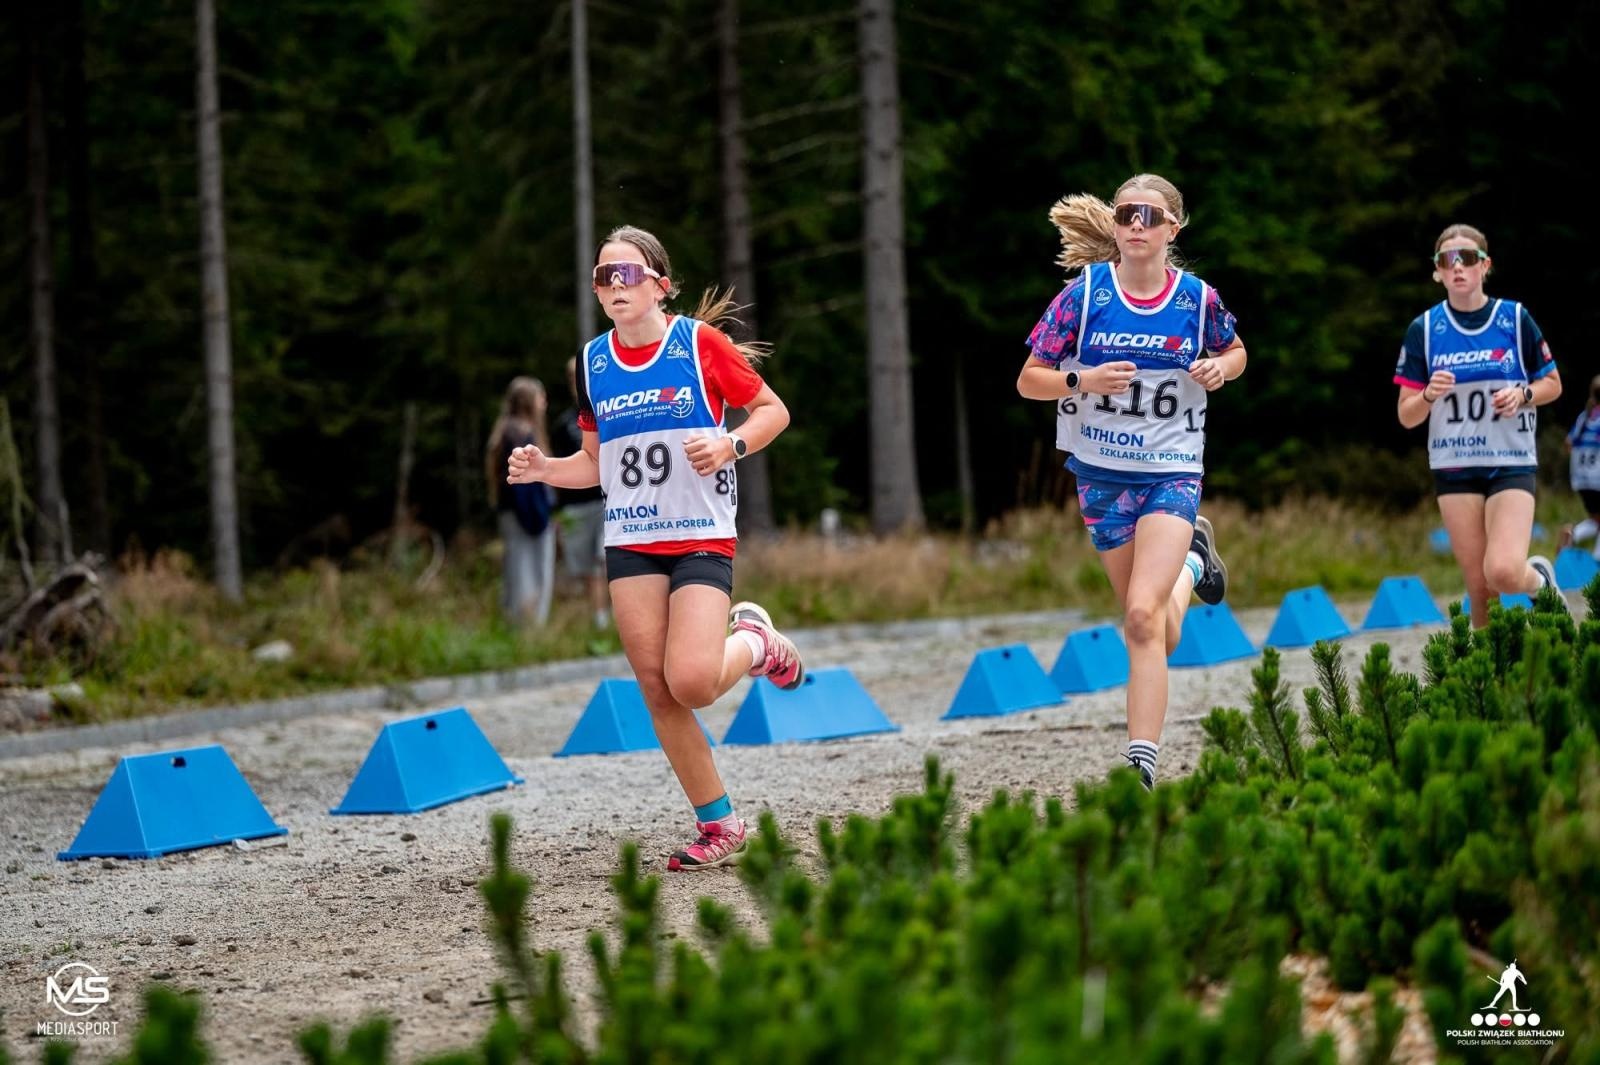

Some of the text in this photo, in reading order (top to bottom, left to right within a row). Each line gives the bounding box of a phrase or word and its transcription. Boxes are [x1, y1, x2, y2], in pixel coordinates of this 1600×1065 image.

[1089, 332, 1192, 351] INCORSA
[1432, 348, 1514, 367] INCORSA
[596, 386, 692, 417] INCORSA
[1099, 447, 1197, 462] SZKLARSKA PORĘBA
[620, 441, 673, 489] 89
[622, 519, 715, 533] SZKLARSKA PORĘBA
